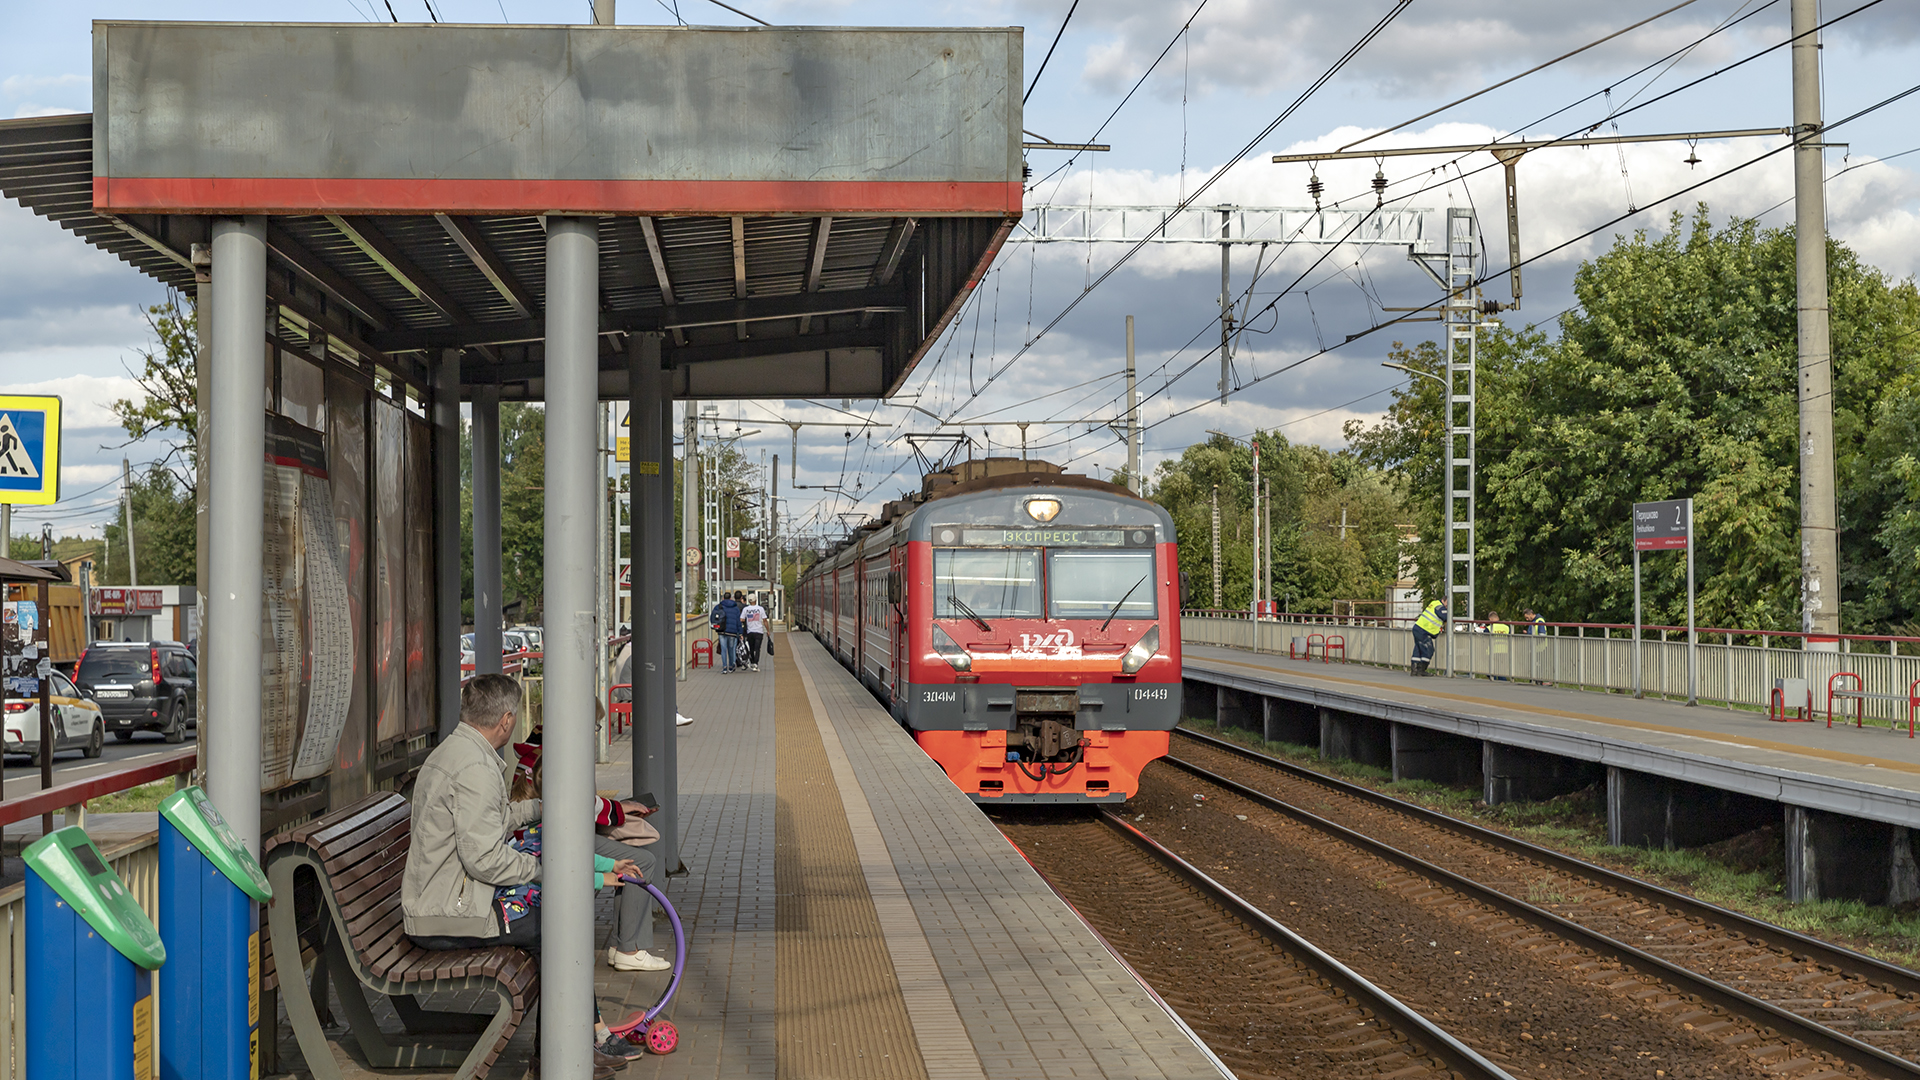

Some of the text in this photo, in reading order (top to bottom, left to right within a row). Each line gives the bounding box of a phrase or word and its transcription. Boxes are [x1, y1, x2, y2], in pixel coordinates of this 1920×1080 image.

[1675, 505, 1681, 525] 2
[1006, 532, 1079, 542] ЭКСПРЕСС
[923, 691, 956, 702] ЭД4М
[1134, 689, 1168, 700] 0449
